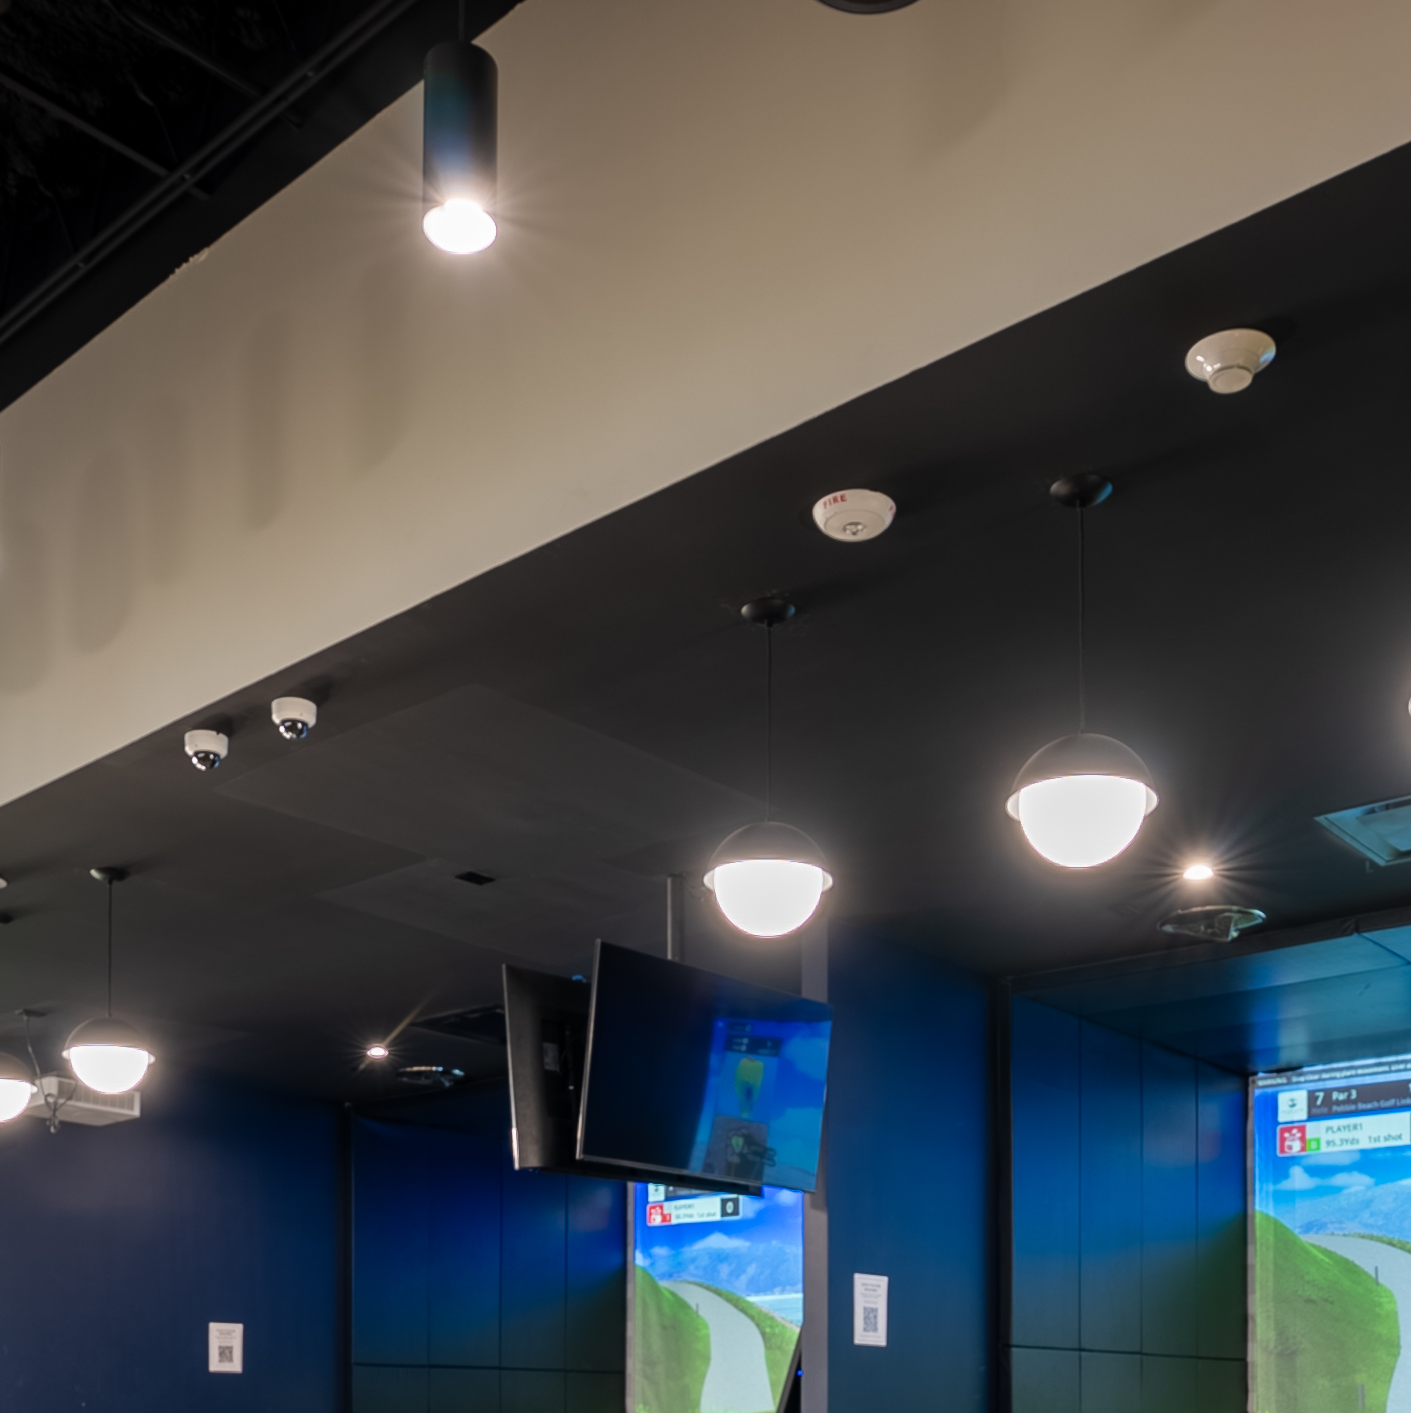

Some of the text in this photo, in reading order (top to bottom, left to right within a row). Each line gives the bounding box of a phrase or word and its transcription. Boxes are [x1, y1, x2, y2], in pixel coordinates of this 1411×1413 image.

[1315, 1091, 1325, 1106] 7
[1332, 1091, 1349, 1101] Par
[1350, 1089, 1358, 1100] 3
